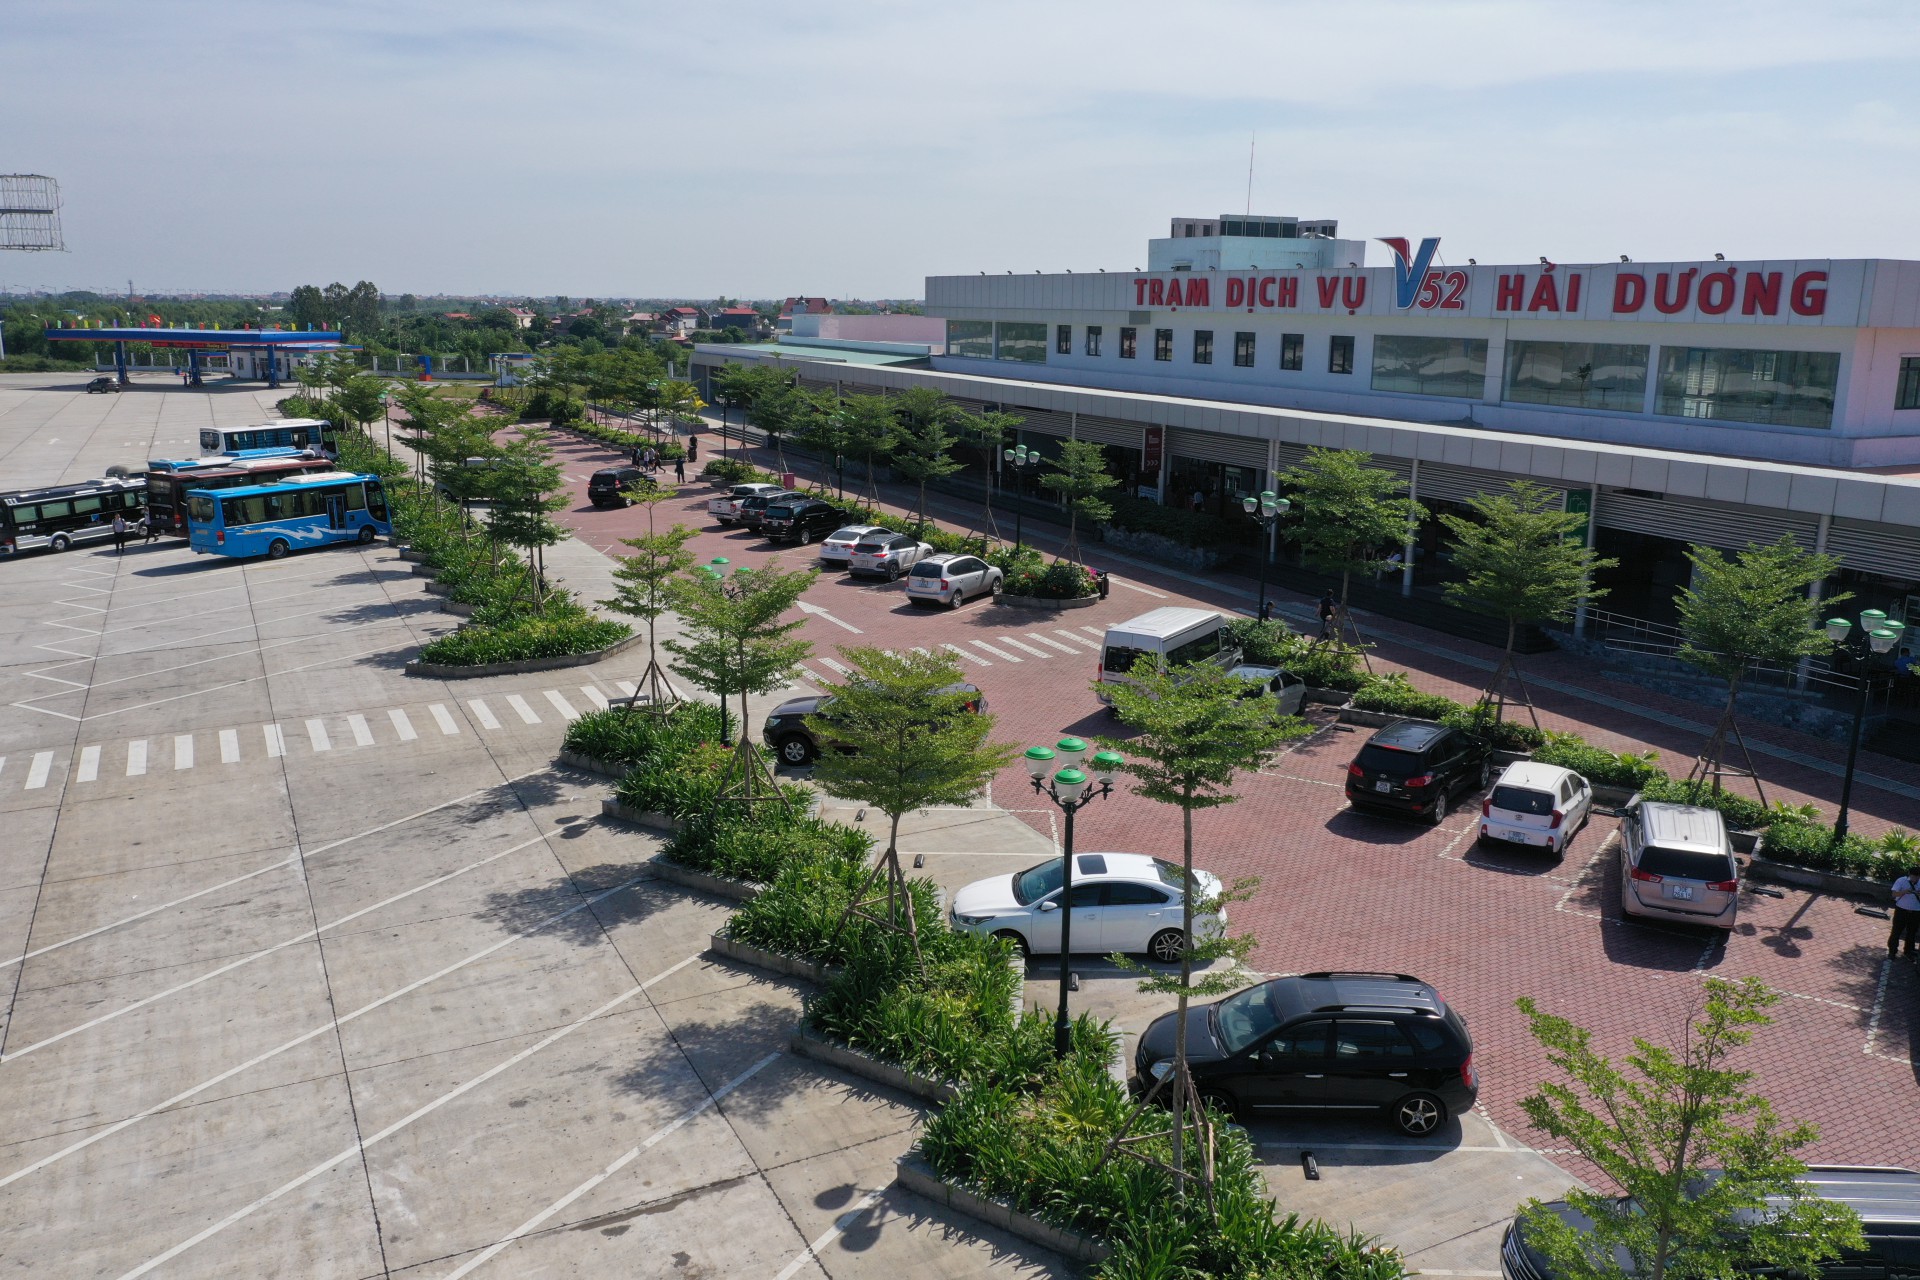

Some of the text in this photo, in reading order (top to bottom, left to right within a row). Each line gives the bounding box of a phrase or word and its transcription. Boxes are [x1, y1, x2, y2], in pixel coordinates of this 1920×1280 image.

[1134, 278, 1209, 312] TRẠM
[1226, 277, 1298, 313] DỊCH
[1317, 276, 1366, 316] VỤ
[1496, 262, 1582, 312] HẢI
[1612, 267, 1828, 316] DƯƠNG
